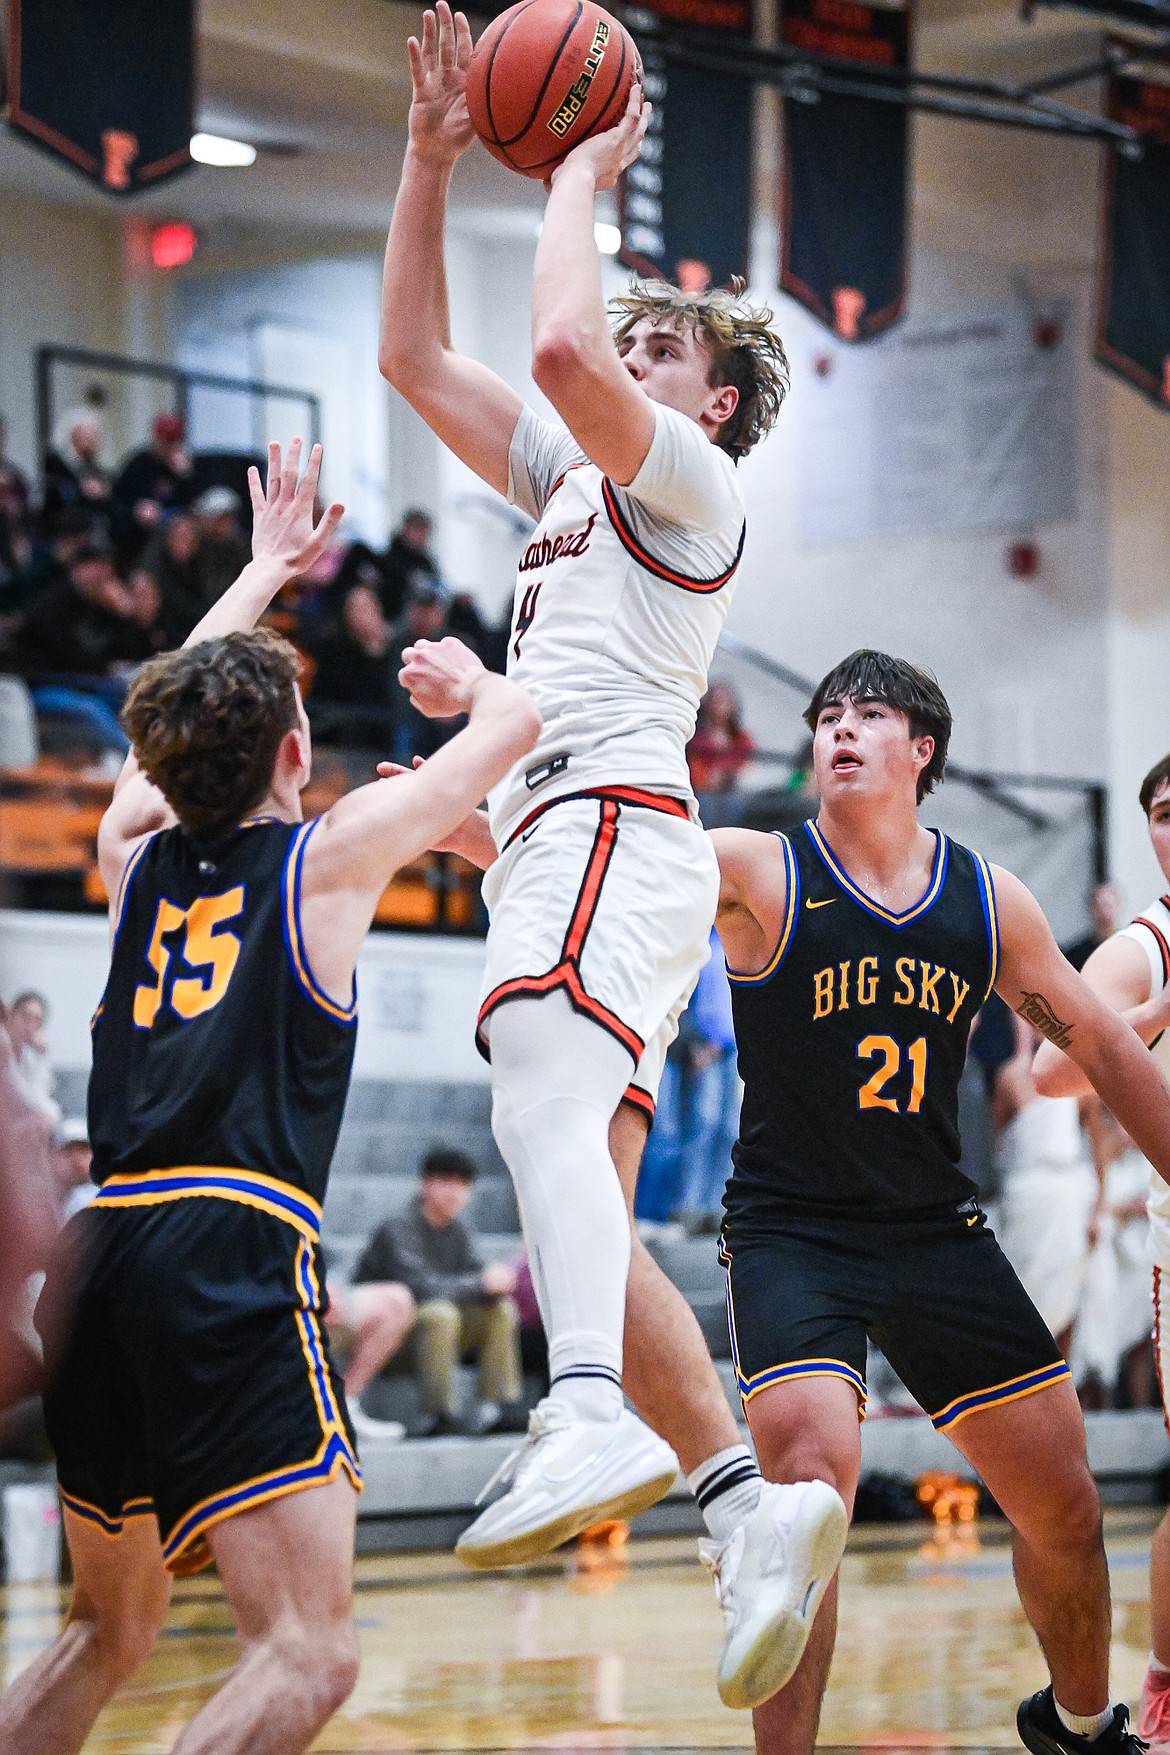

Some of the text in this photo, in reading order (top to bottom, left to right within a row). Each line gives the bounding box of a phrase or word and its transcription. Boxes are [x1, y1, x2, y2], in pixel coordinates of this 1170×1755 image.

[572, 19, 611, 99] ELITE
[547, 90, 586, 138] PRO
[513, 581, 544, 661] 4
[132, 882, 247, 1031] 55
[812, 955, 971, 1024] BIG SKY
[856, 1033, 929, 1114] 21
